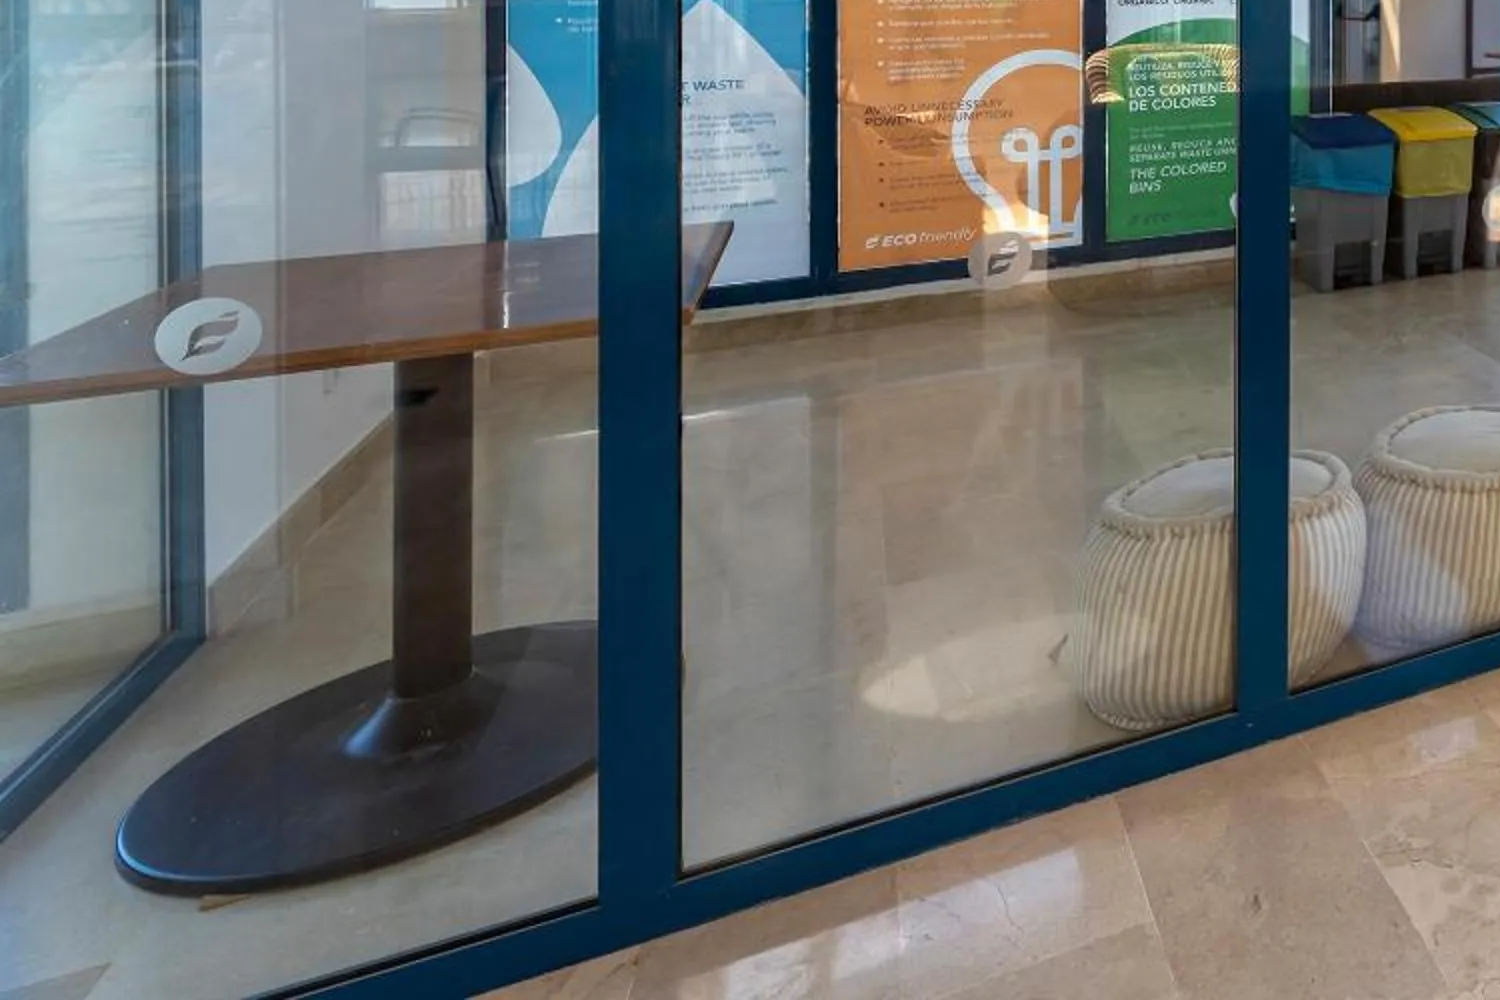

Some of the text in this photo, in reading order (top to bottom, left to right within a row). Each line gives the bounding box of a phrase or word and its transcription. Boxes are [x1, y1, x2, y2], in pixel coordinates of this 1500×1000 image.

[692, 79, 745, 92] WASTE
[1129, 81, 1239, 98] LOS CONTENED
[1129, 95, 1217, 112] DE COLORES
[1130, 161, 1227, 180] THE COLORED
[882, 233, 917, 247] ECO
